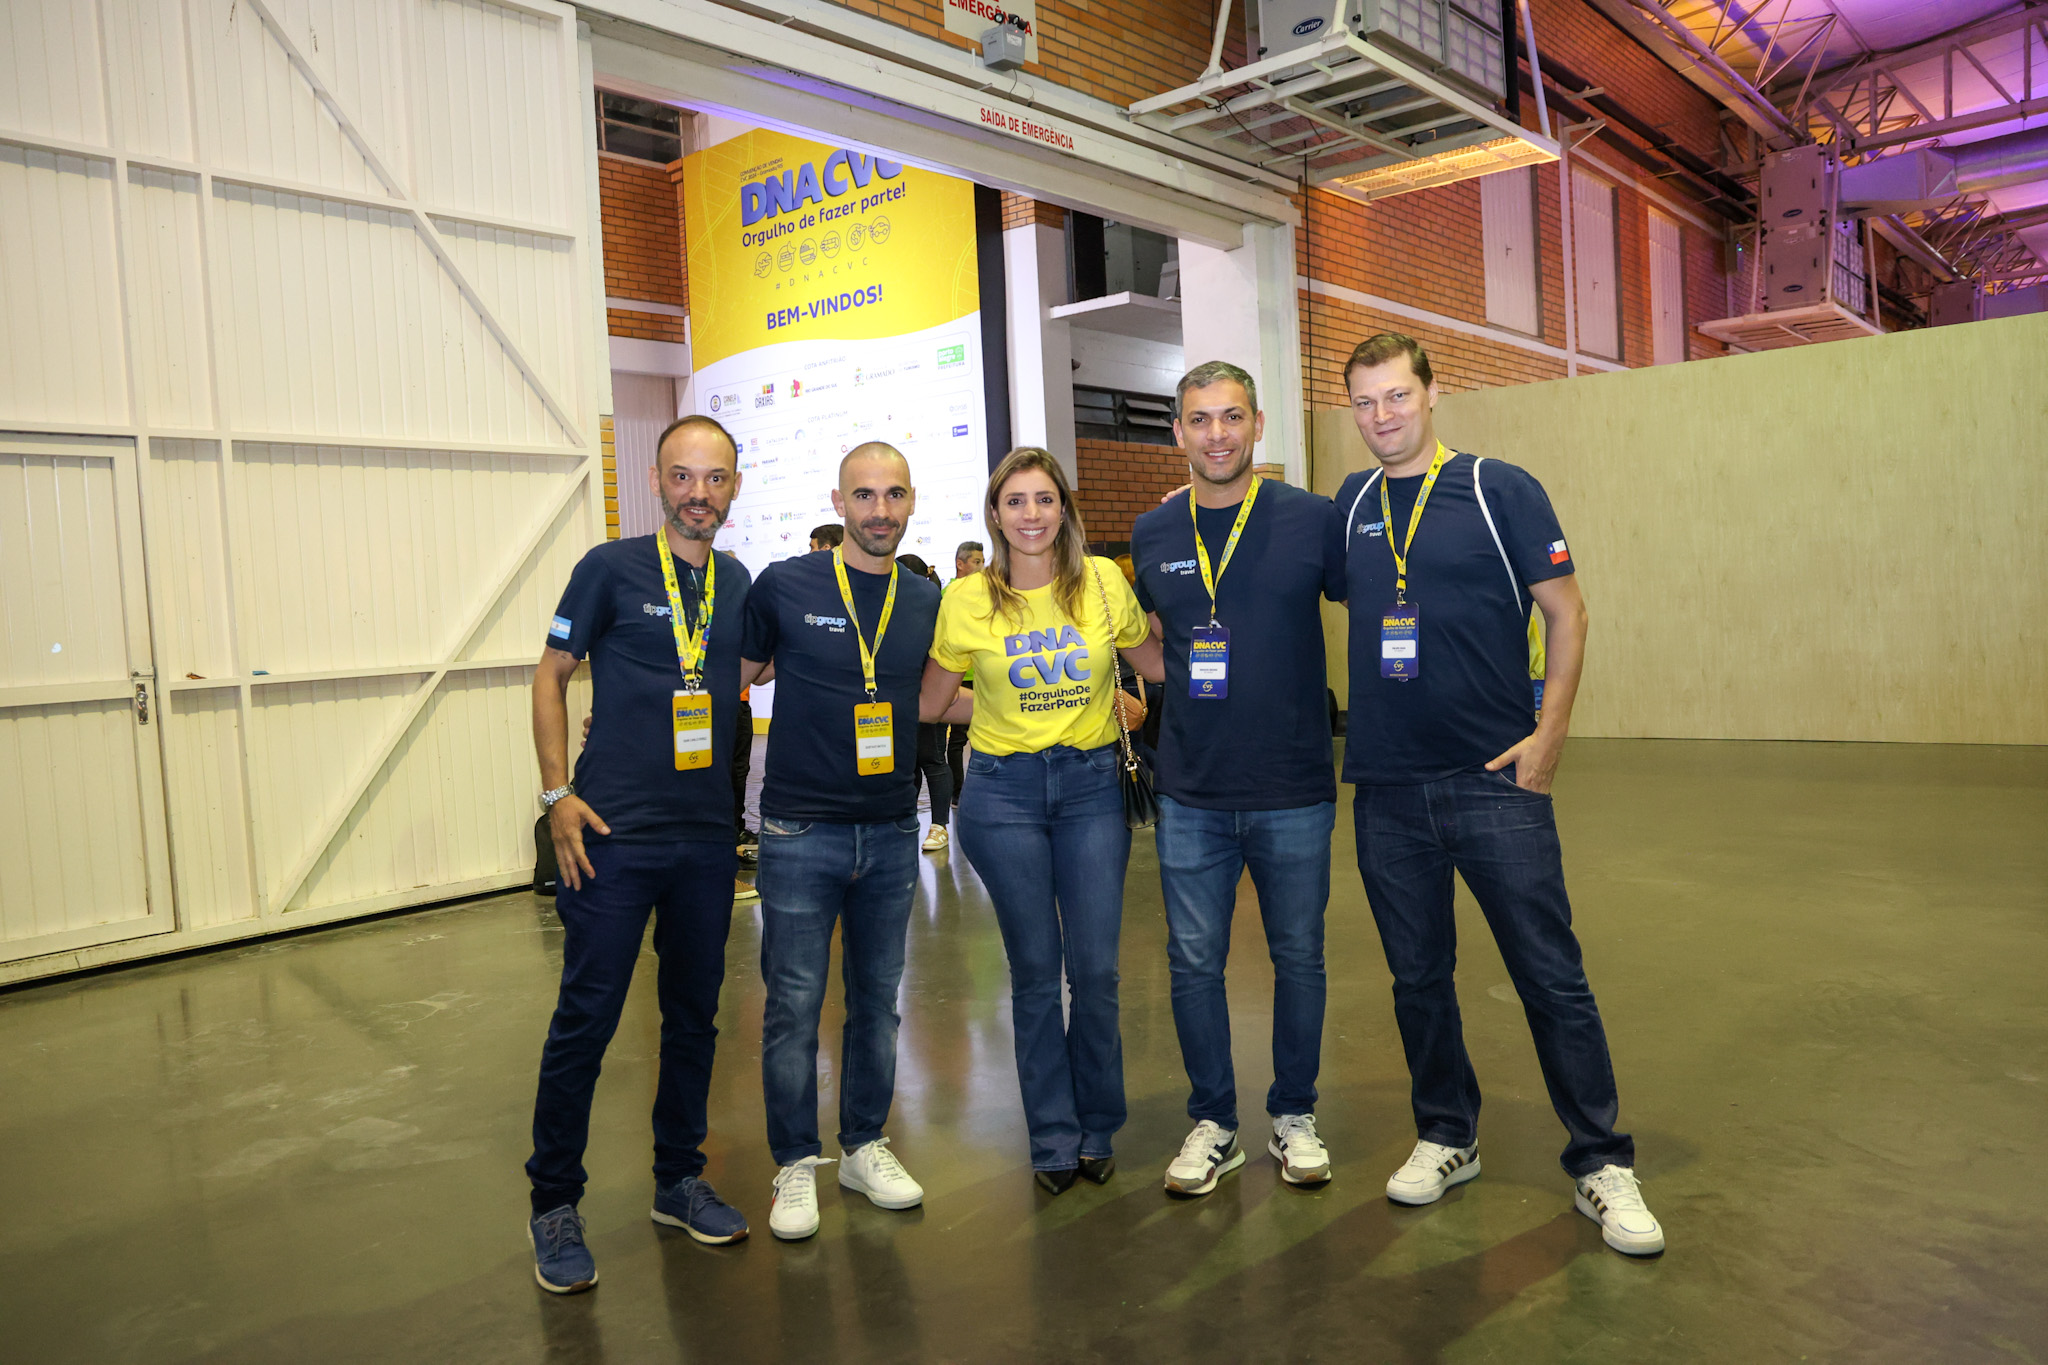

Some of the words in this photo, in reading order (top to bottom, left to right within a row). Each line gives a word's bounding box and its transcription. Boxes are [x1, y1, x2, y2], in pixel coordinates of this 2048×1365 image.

[949, 0, 1033, 36] MERGNA
[1295, 20, 1321, 34] Carrier
[980, 106, 1006, 129] SAÍDA
[1008, 116, 1020, 133] DE
[1022, 121, 1074, 150] EMERGÊNCIA
[742, 221, 795, 247] Orgulho
[799, 214, 815, 229] de
[819, 202, 856, 223] fazer
[861, 182, 906, 214] parte!
[766, 283, 883, 330] BEM-VINDOS!
[1004, 625, 1087, 657] DNA
[1008, 648, 1091, 689] CVC
[1019, 685, 1091, 701] #OrgulhoDe
[1020, 696, 1091, 713] FazerParte
